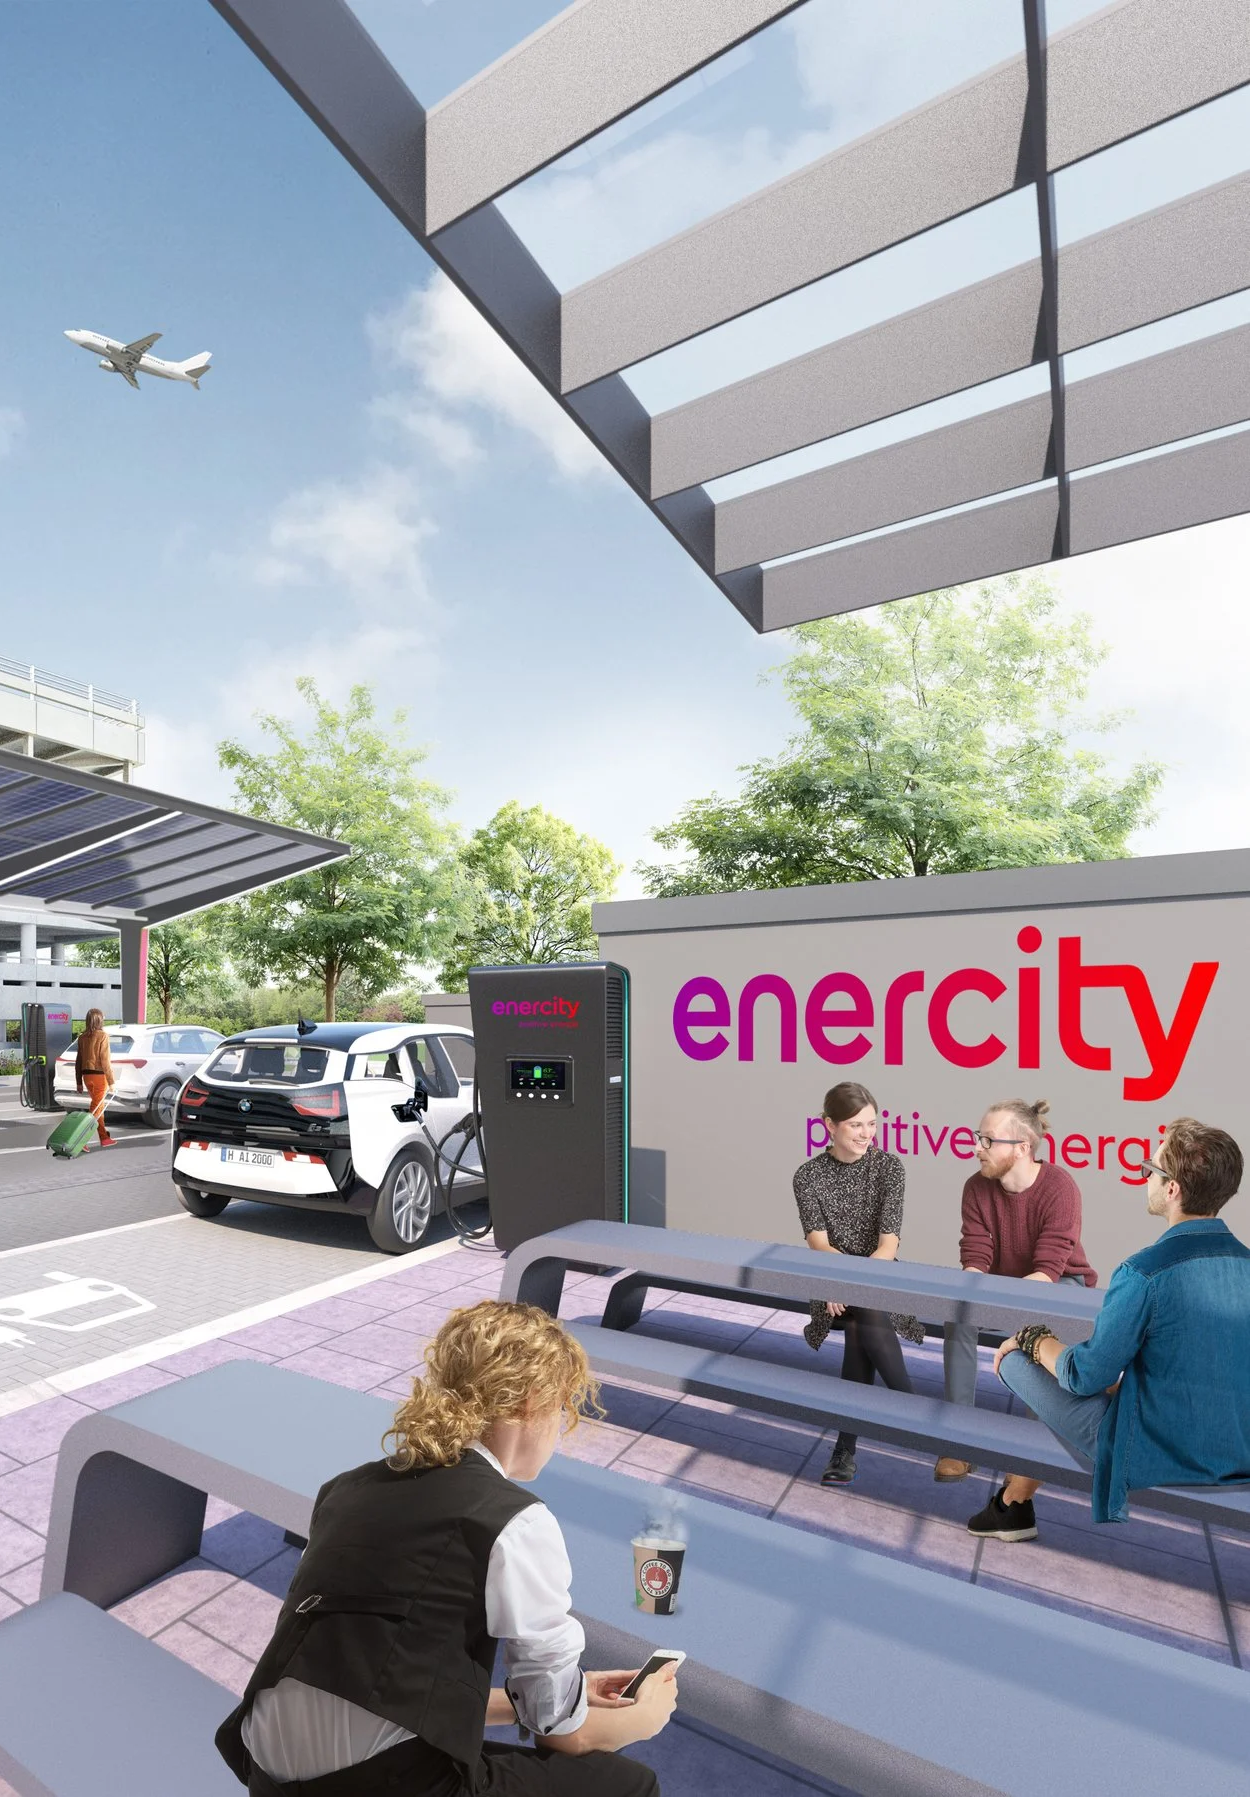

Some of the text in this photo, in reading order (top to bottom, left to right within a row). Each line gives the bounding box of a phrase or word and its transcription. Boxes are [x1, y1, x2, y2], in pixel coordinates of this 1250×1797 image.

[491, 996, 580, 1019] enercity
[673, 926, 1220, 1102] enercity
[806, 1110, 976, 1160] pitive
[228, 1150, 272, 1165] H AI 2000
[642, 1562, 658, 1574] COFFEE
